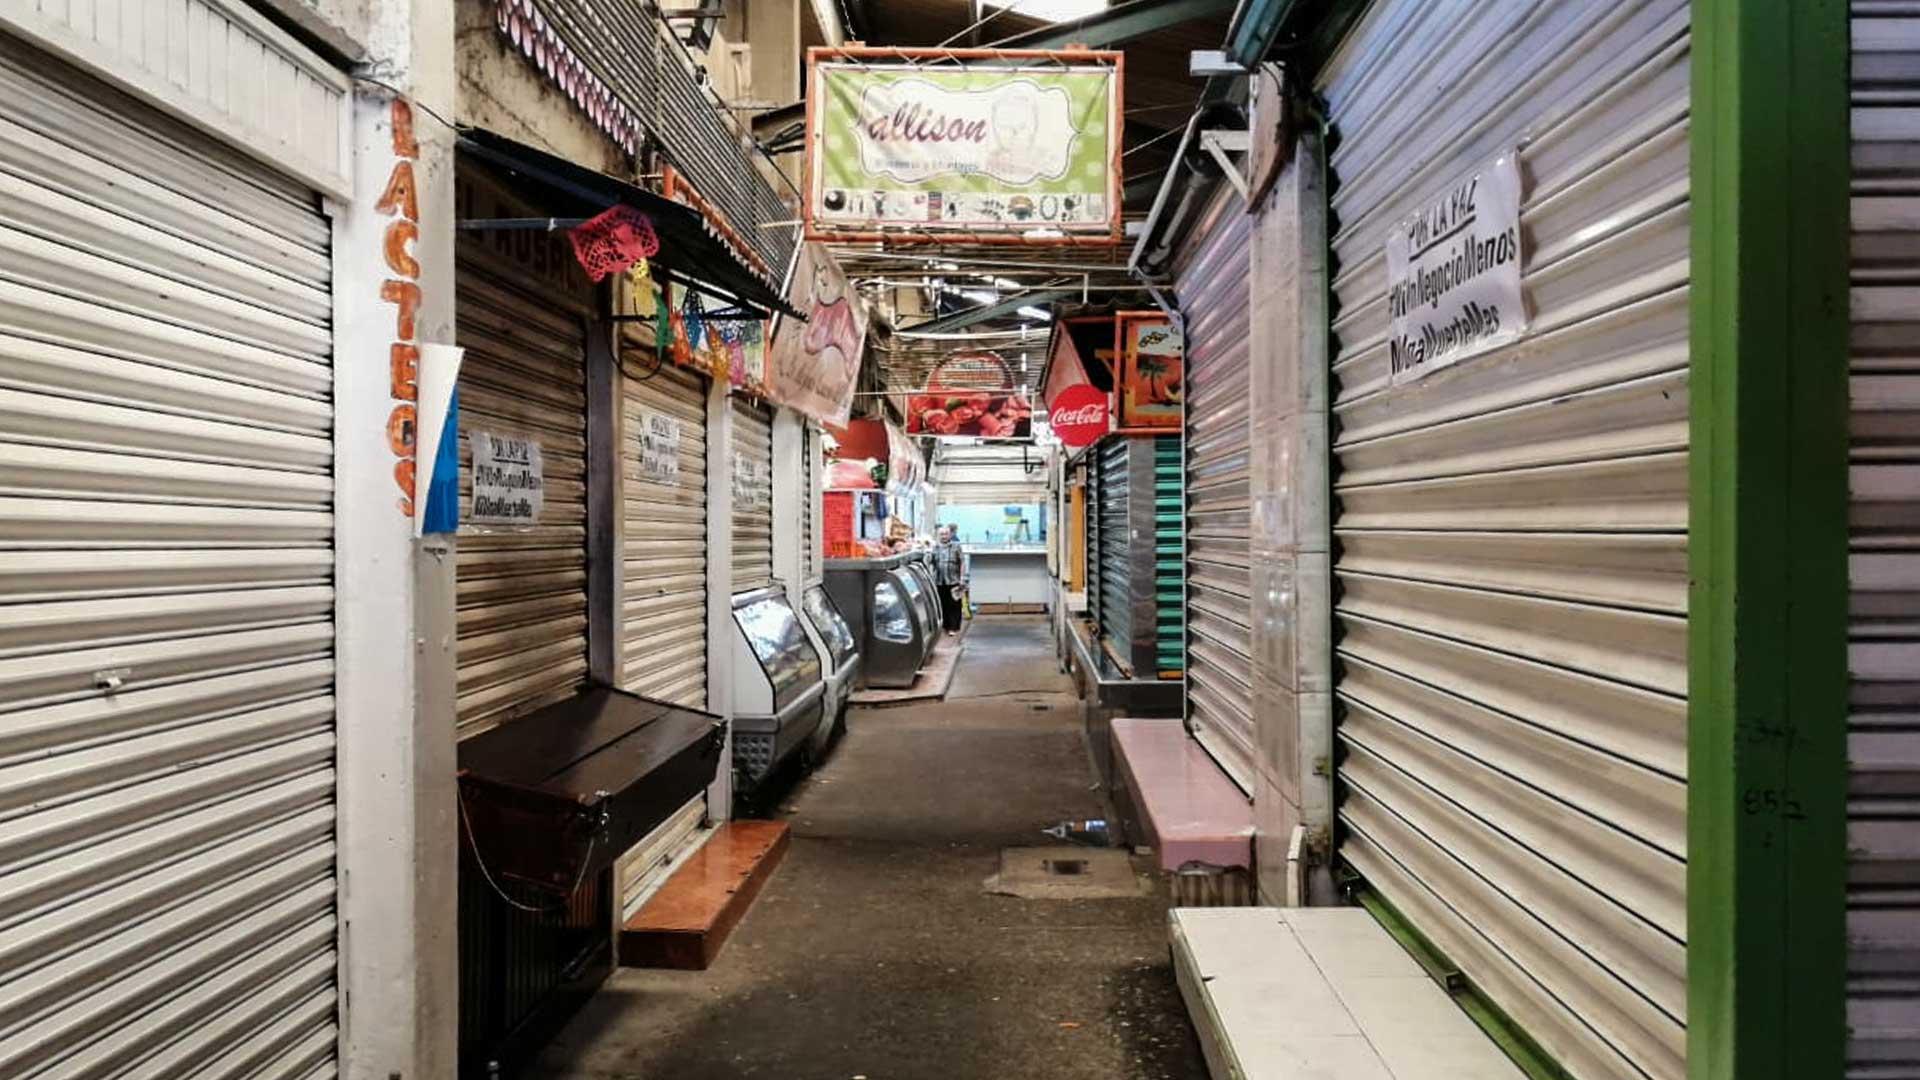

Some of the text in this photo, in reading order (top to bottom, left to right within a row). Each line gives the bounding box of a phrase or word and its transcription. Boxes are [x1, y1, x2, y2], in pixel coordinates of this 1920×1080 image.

[867, 101, 987, 143] allison
[1433, 200, 1447, 237] LA
[1452, 178, 1478, 226] PAZ
[375, 98, 422, 518] LACTEOS
